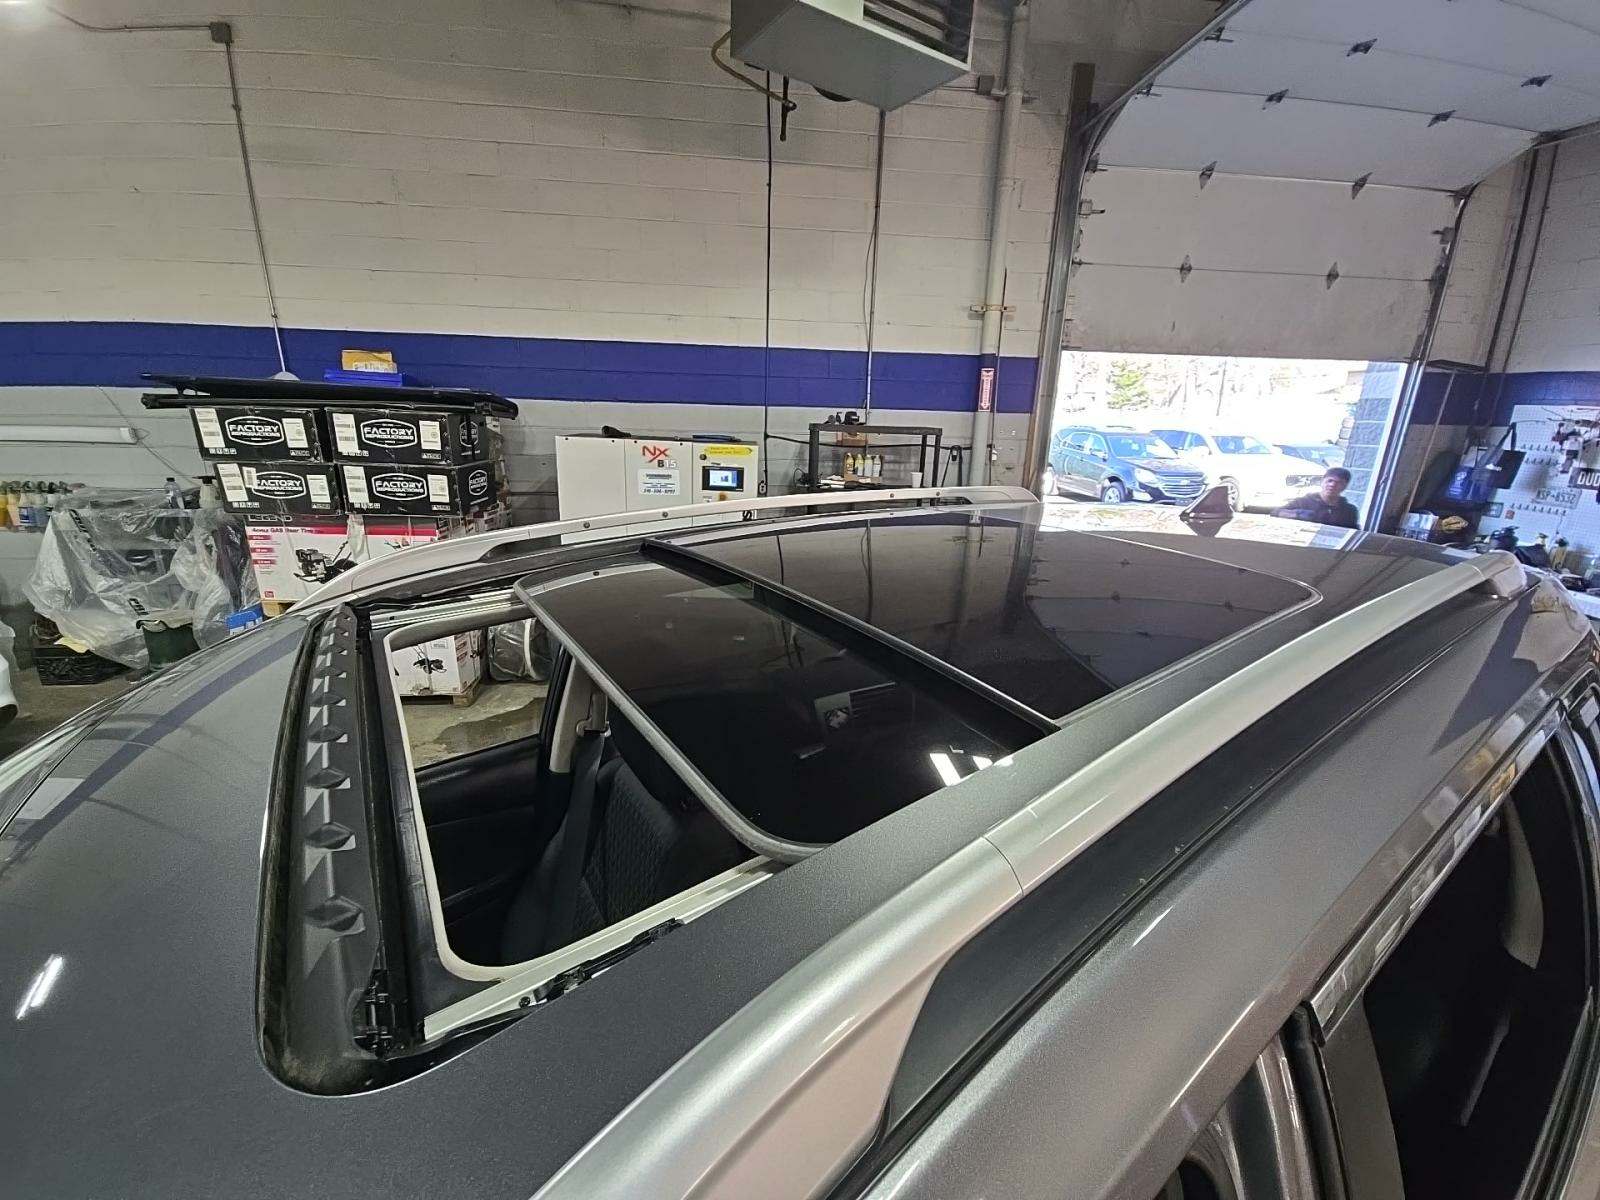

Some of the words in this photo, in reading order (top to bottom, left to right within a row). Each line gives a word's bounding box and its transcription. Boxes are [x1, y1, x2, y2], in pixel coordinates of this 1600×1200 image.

[229, 424, 279, 432] FACTORY
[363, 427, 413, 436] FACTORY
[642, 445, 670, 463] NX
[375, 481, 423, 489] FACTORY
